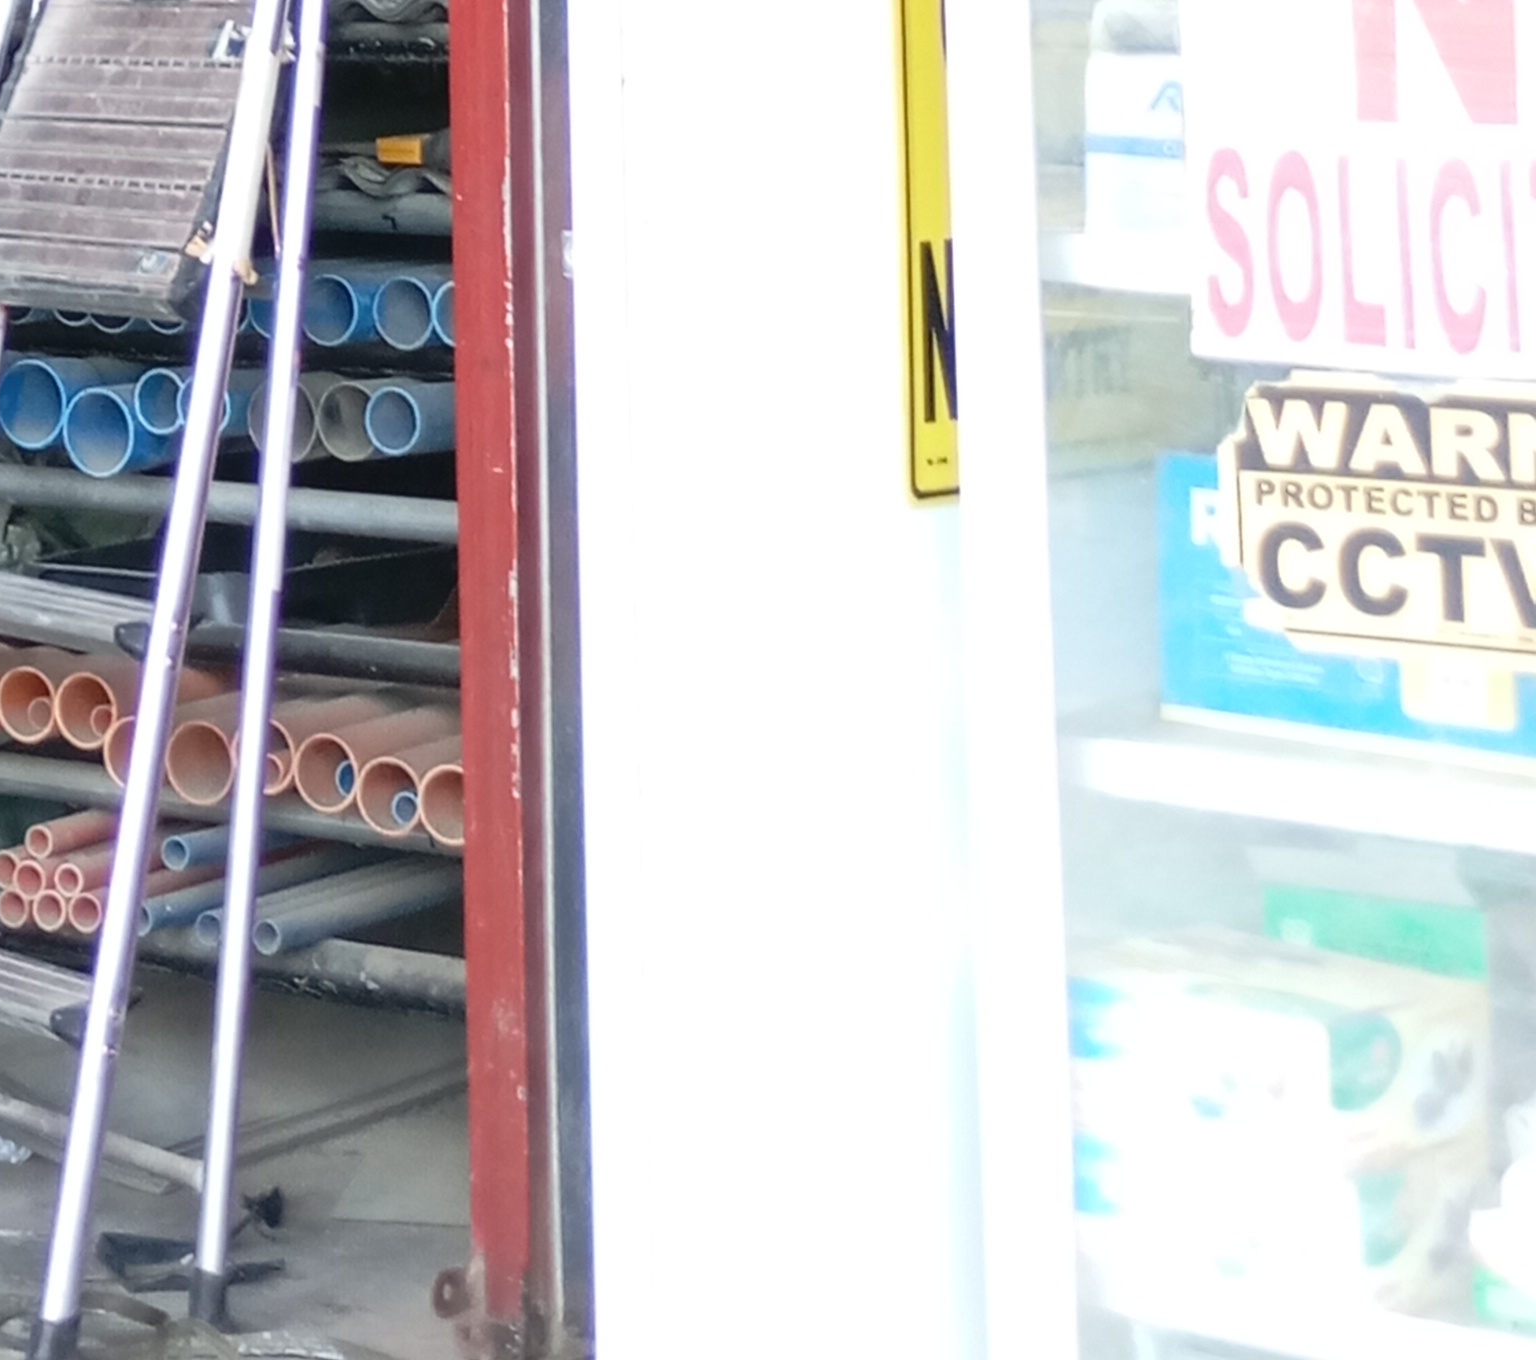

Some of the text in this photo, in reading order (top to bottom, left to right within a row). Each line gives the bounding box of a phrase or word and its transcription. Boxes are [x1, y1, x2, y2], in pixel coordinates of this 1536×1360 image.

[1205, 146, 1536, 356] SOLICI
[1254, 478, 1499, 524] PROTECTED
[1258, 520, 1536, 630] CCTV
